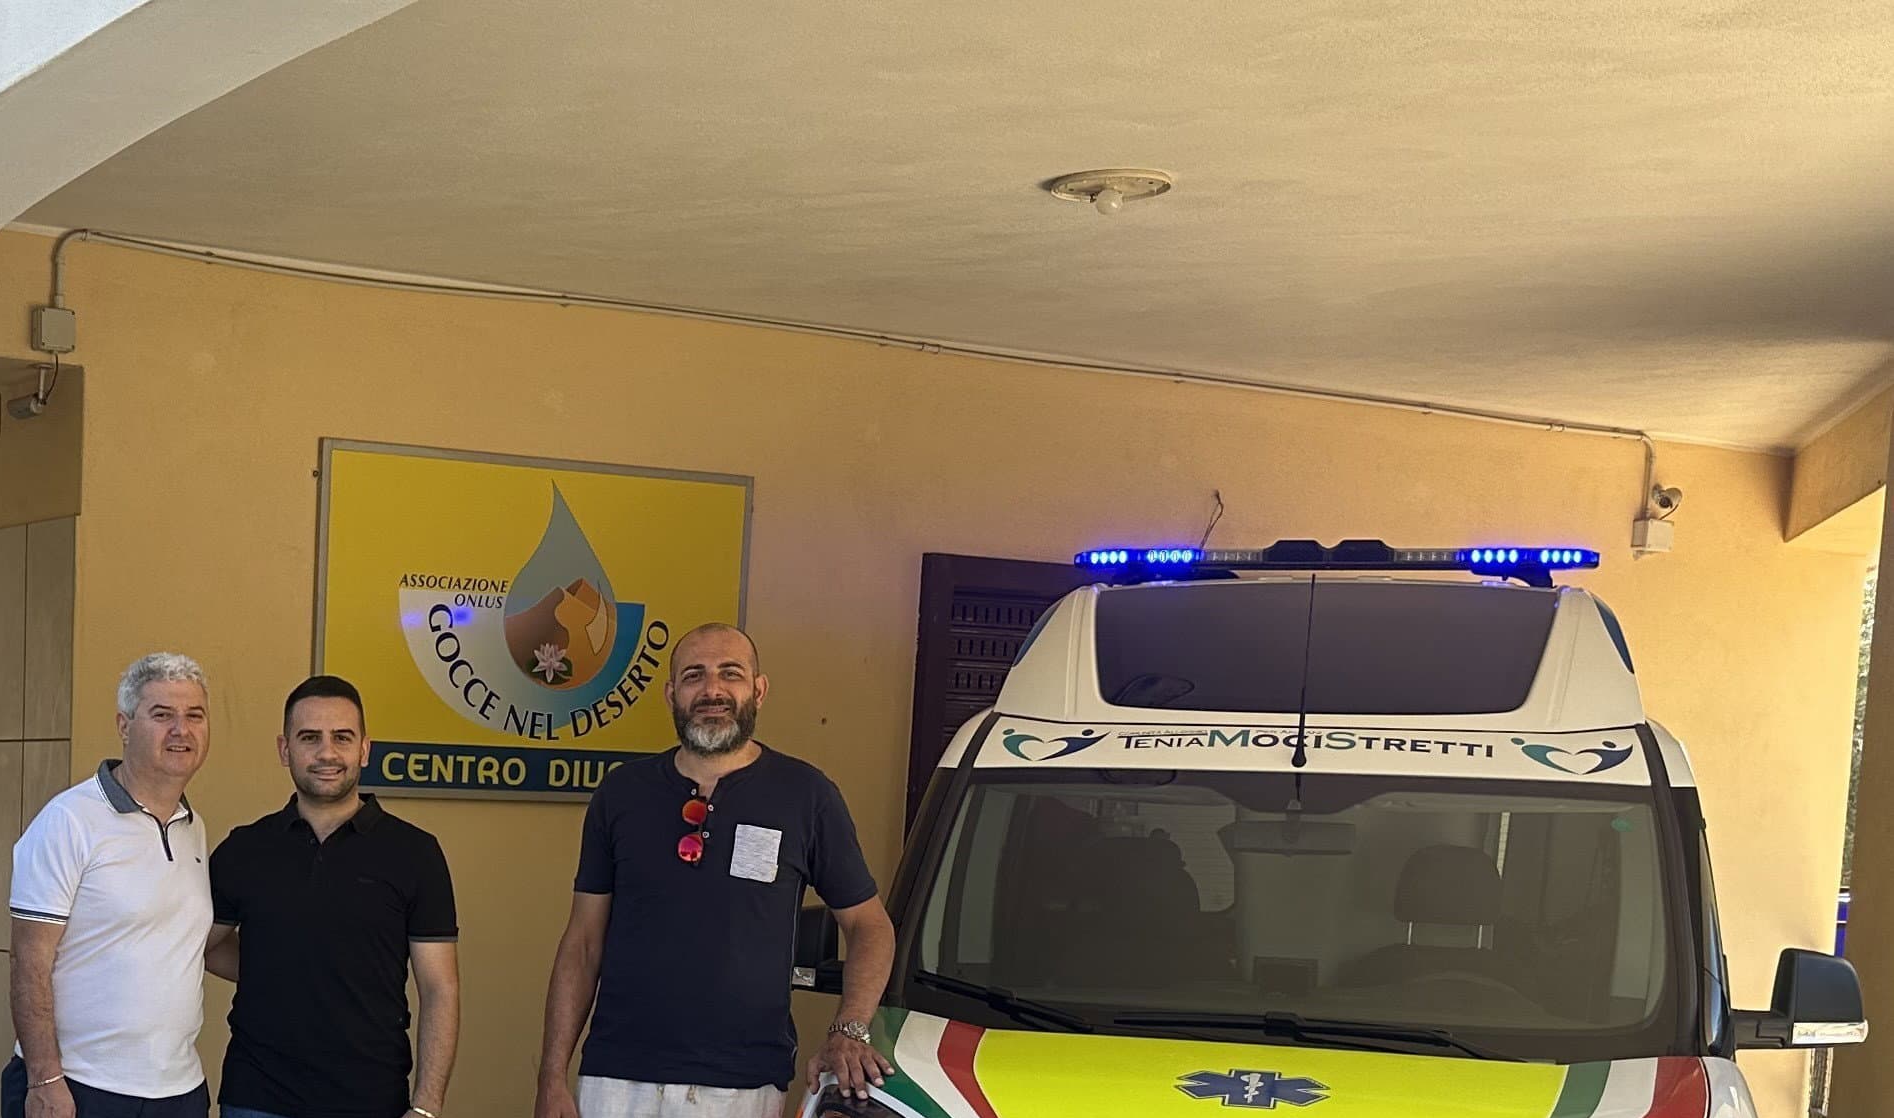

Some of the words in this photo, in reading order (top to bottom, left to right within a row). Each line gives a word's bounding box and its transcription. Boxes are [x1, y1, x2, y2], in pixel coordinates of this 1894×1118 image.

[399, 574, 508, 593] ASSOCIAZIONE
[454, 593, 503, 609] ONLUS
[428, 604, 501, 721] GOCCE
[503, 704, 559, 741] NEL
[570, 619, 670, 738] DESERTO
[381, 751, 527, 786] CENTRO
[548, 758, 625, 788] DIU
